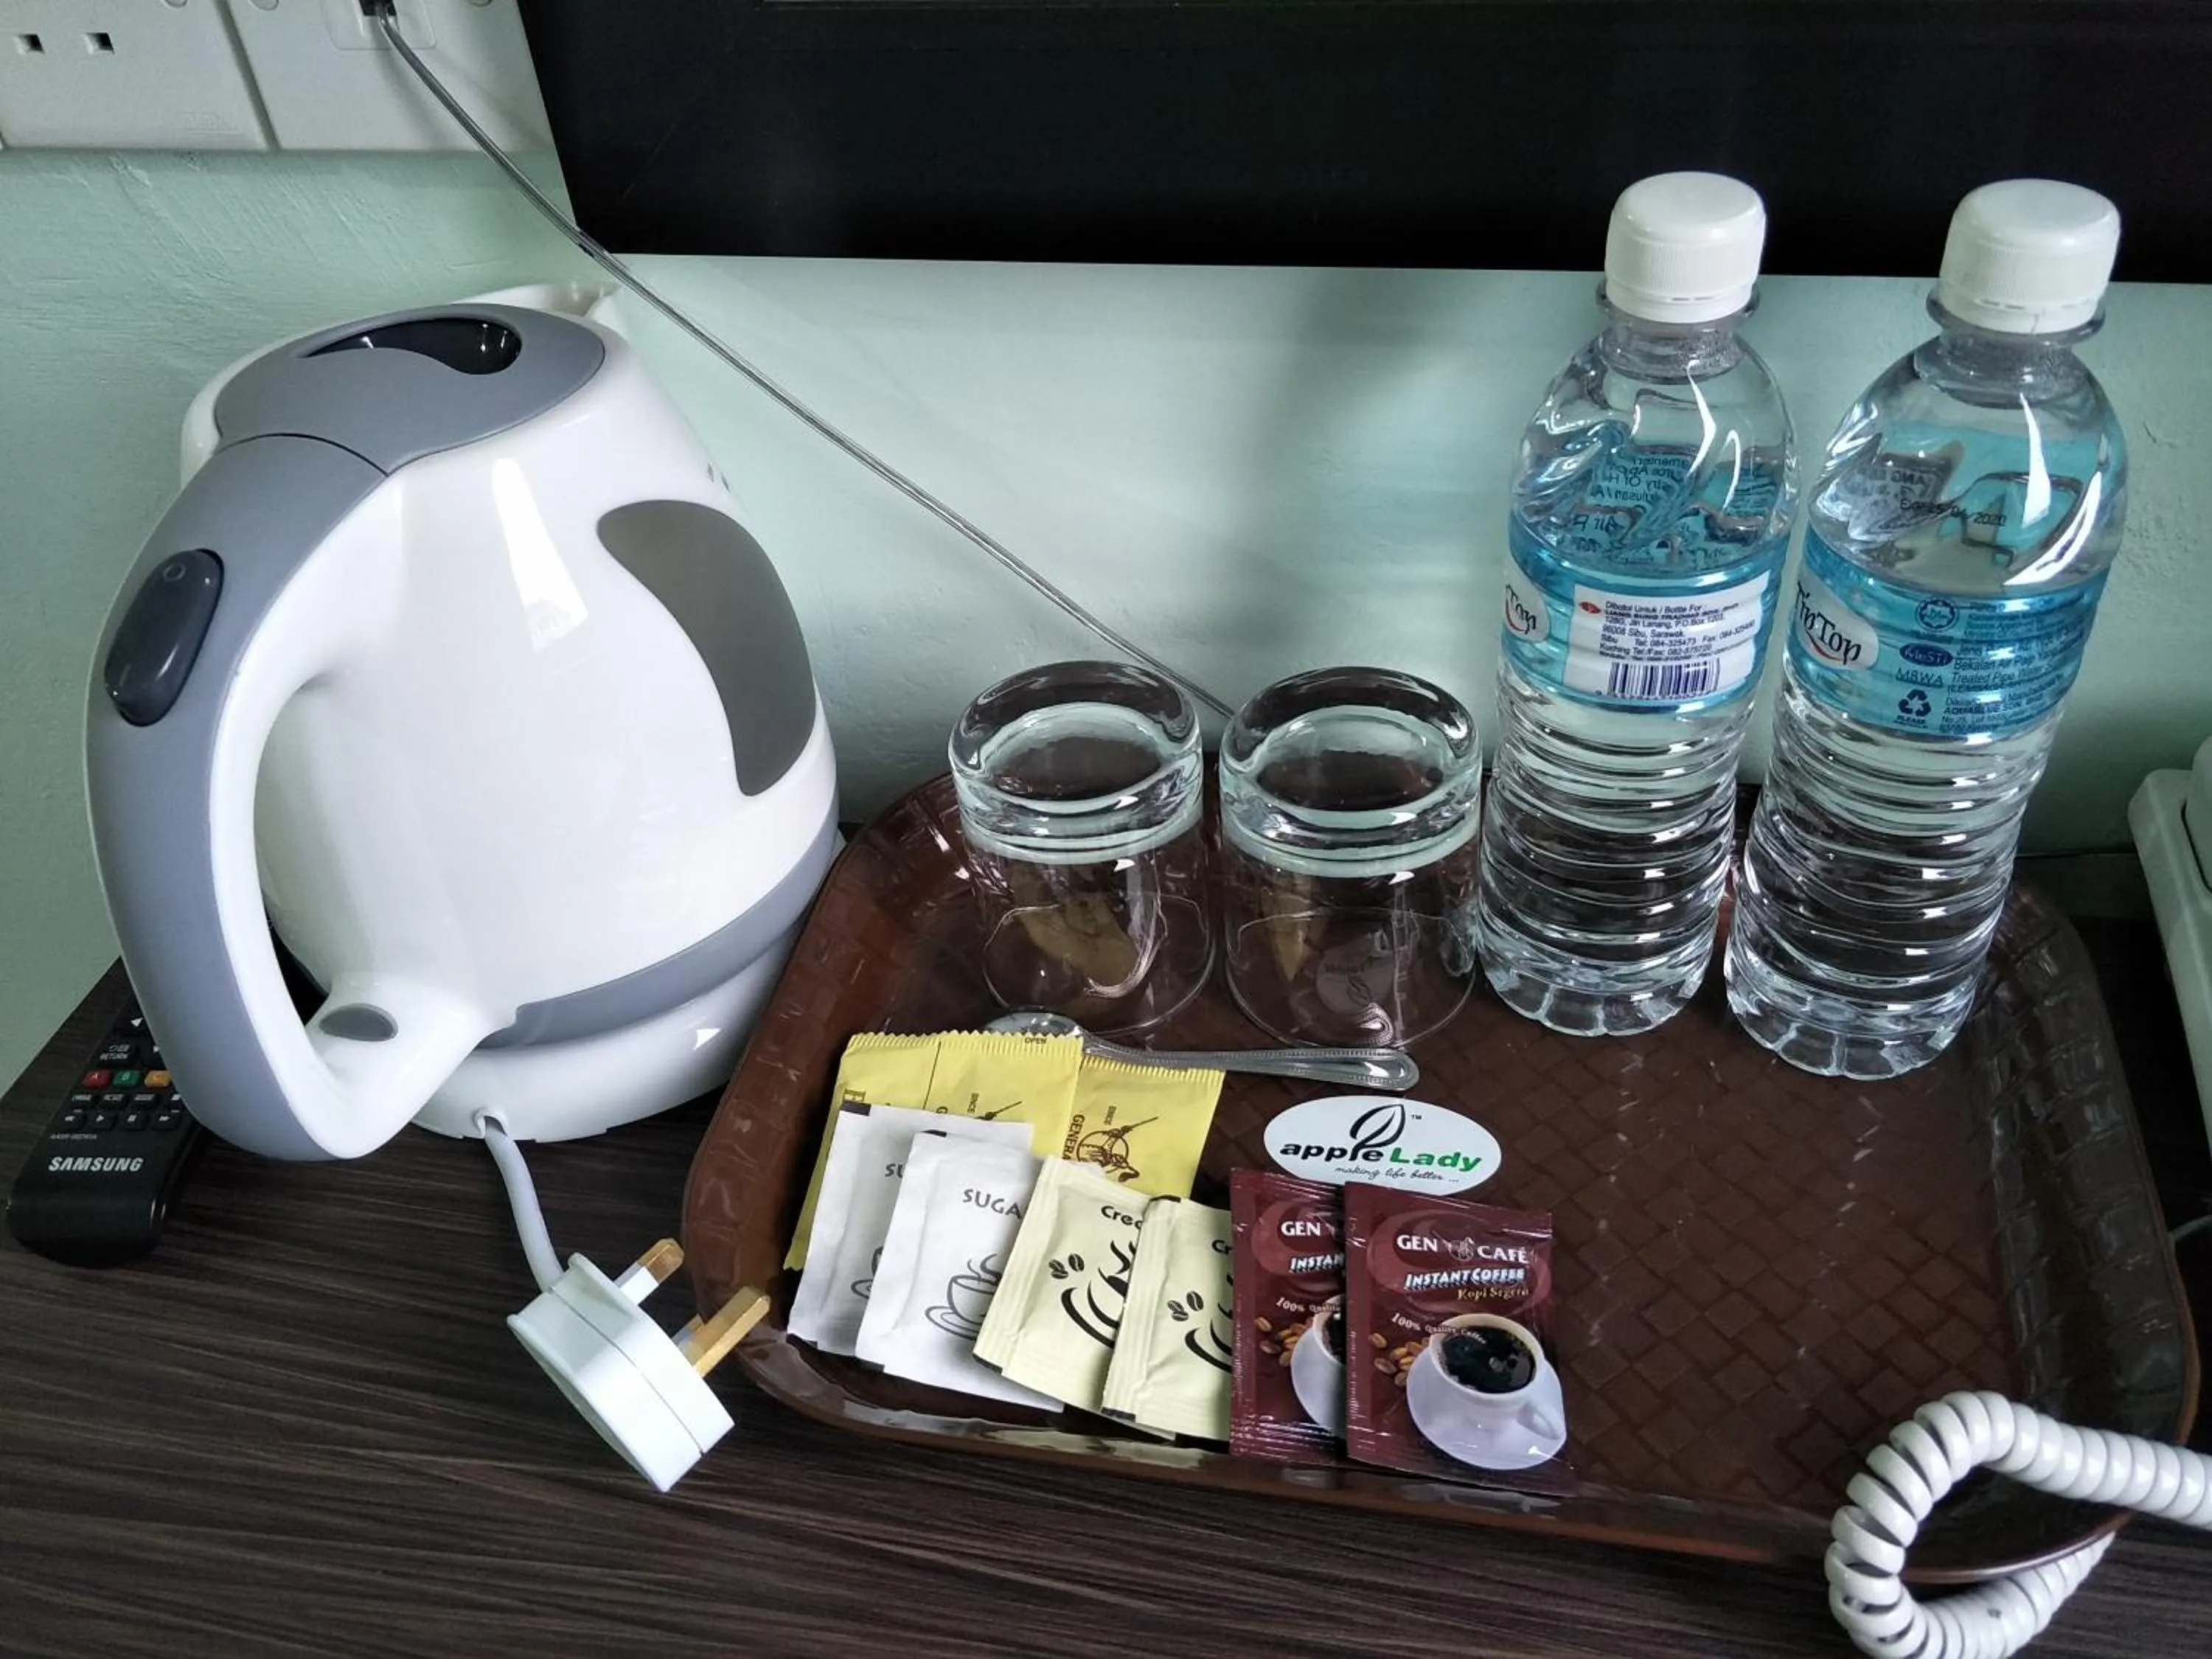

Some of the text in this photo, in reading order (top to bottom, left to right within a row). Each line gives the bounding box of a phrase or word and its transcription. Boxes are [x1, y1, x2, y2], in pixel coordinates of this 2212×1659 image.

[48, 1156, 145, 1172] SAMSUNG
[1334, 1166, 1380, 1180] making
[1385, 1166, 1406, 1178] life
[1281, 1221, 1321, 1237] GEN
[1397, 1234, 1439, 1252] GEN
[1456, 1289, 1487, 1301] Kopi
[1276, 1297, 1305, 1312] 100%
[1391, 1312, 1422, 1332] 100%
